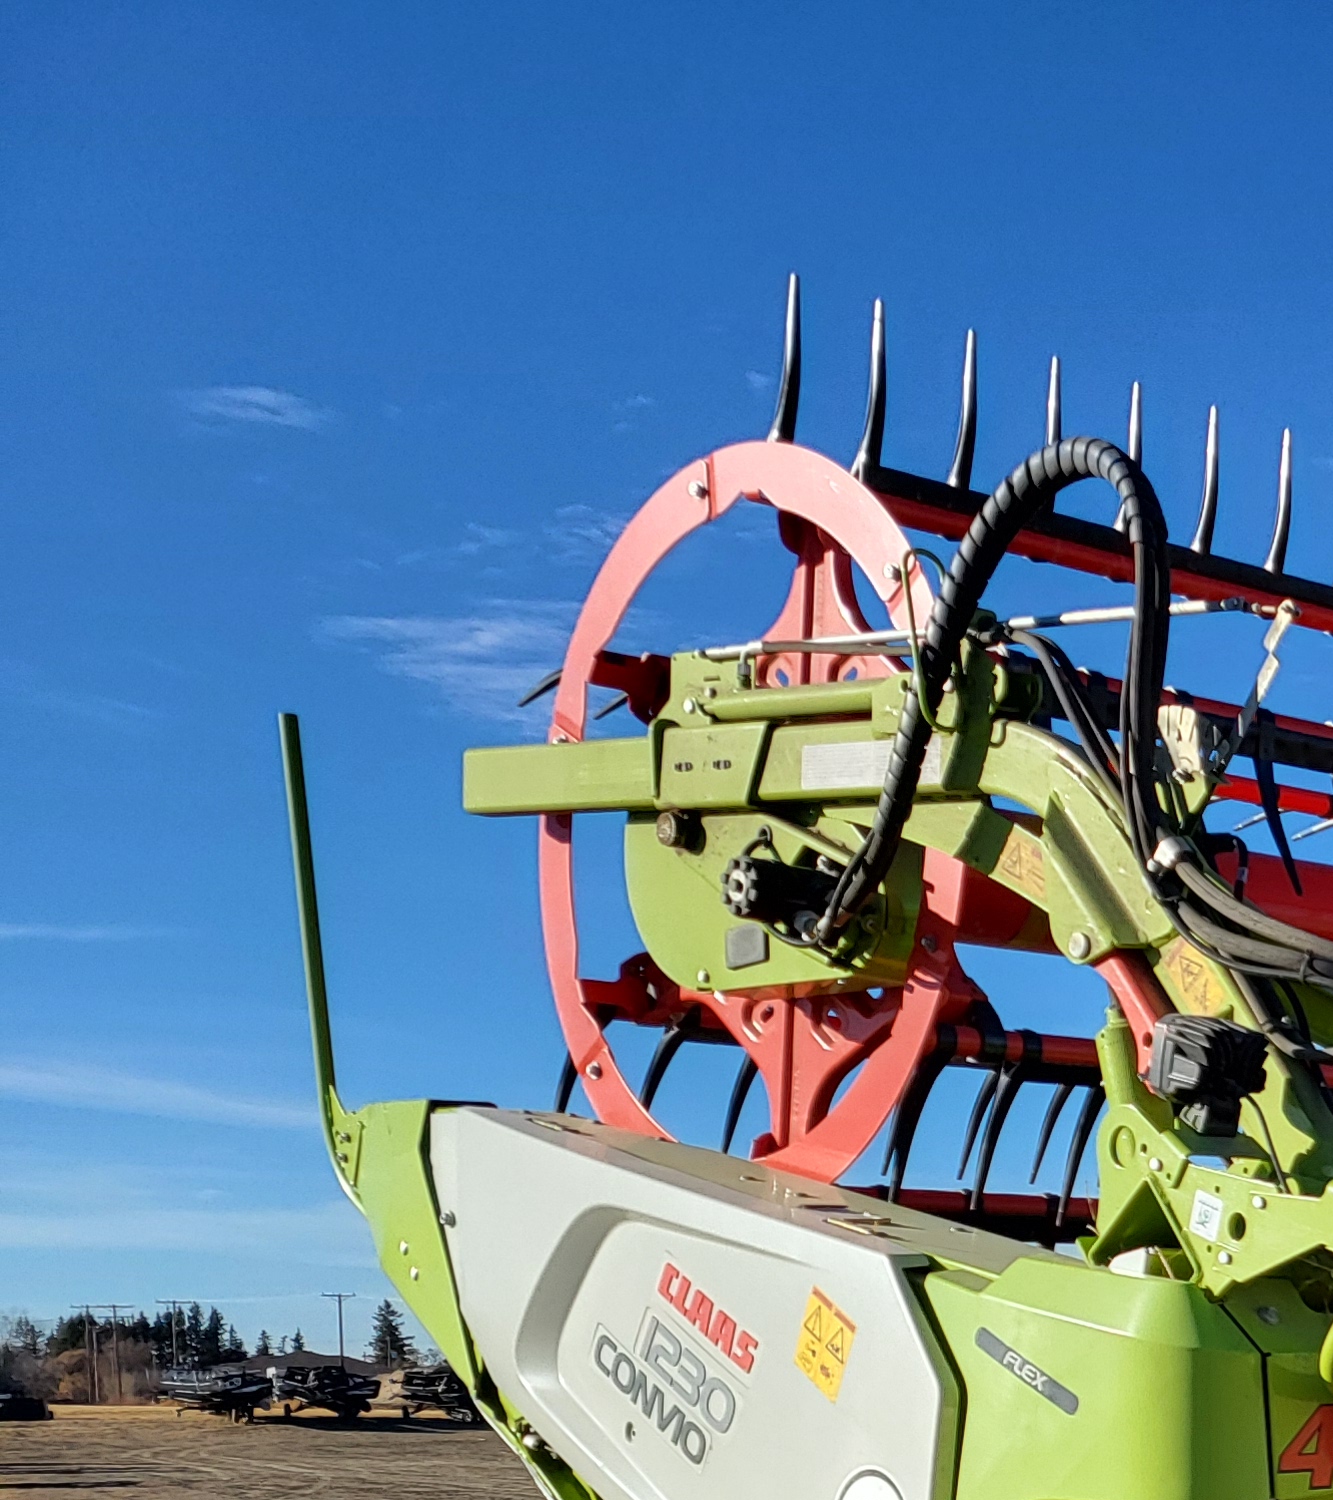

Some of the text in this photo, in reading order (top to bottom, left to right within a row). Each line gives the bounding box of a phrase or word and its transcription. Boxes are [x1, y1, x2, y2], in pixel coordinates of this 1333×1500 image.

[639, 1316, 736, 1434] 1230
[657, 1262, 759, 1374] CLAAS
[1002, 1350, 1050, 1391] FLEX
[594, 1334, 707, 1465] CONVIO
